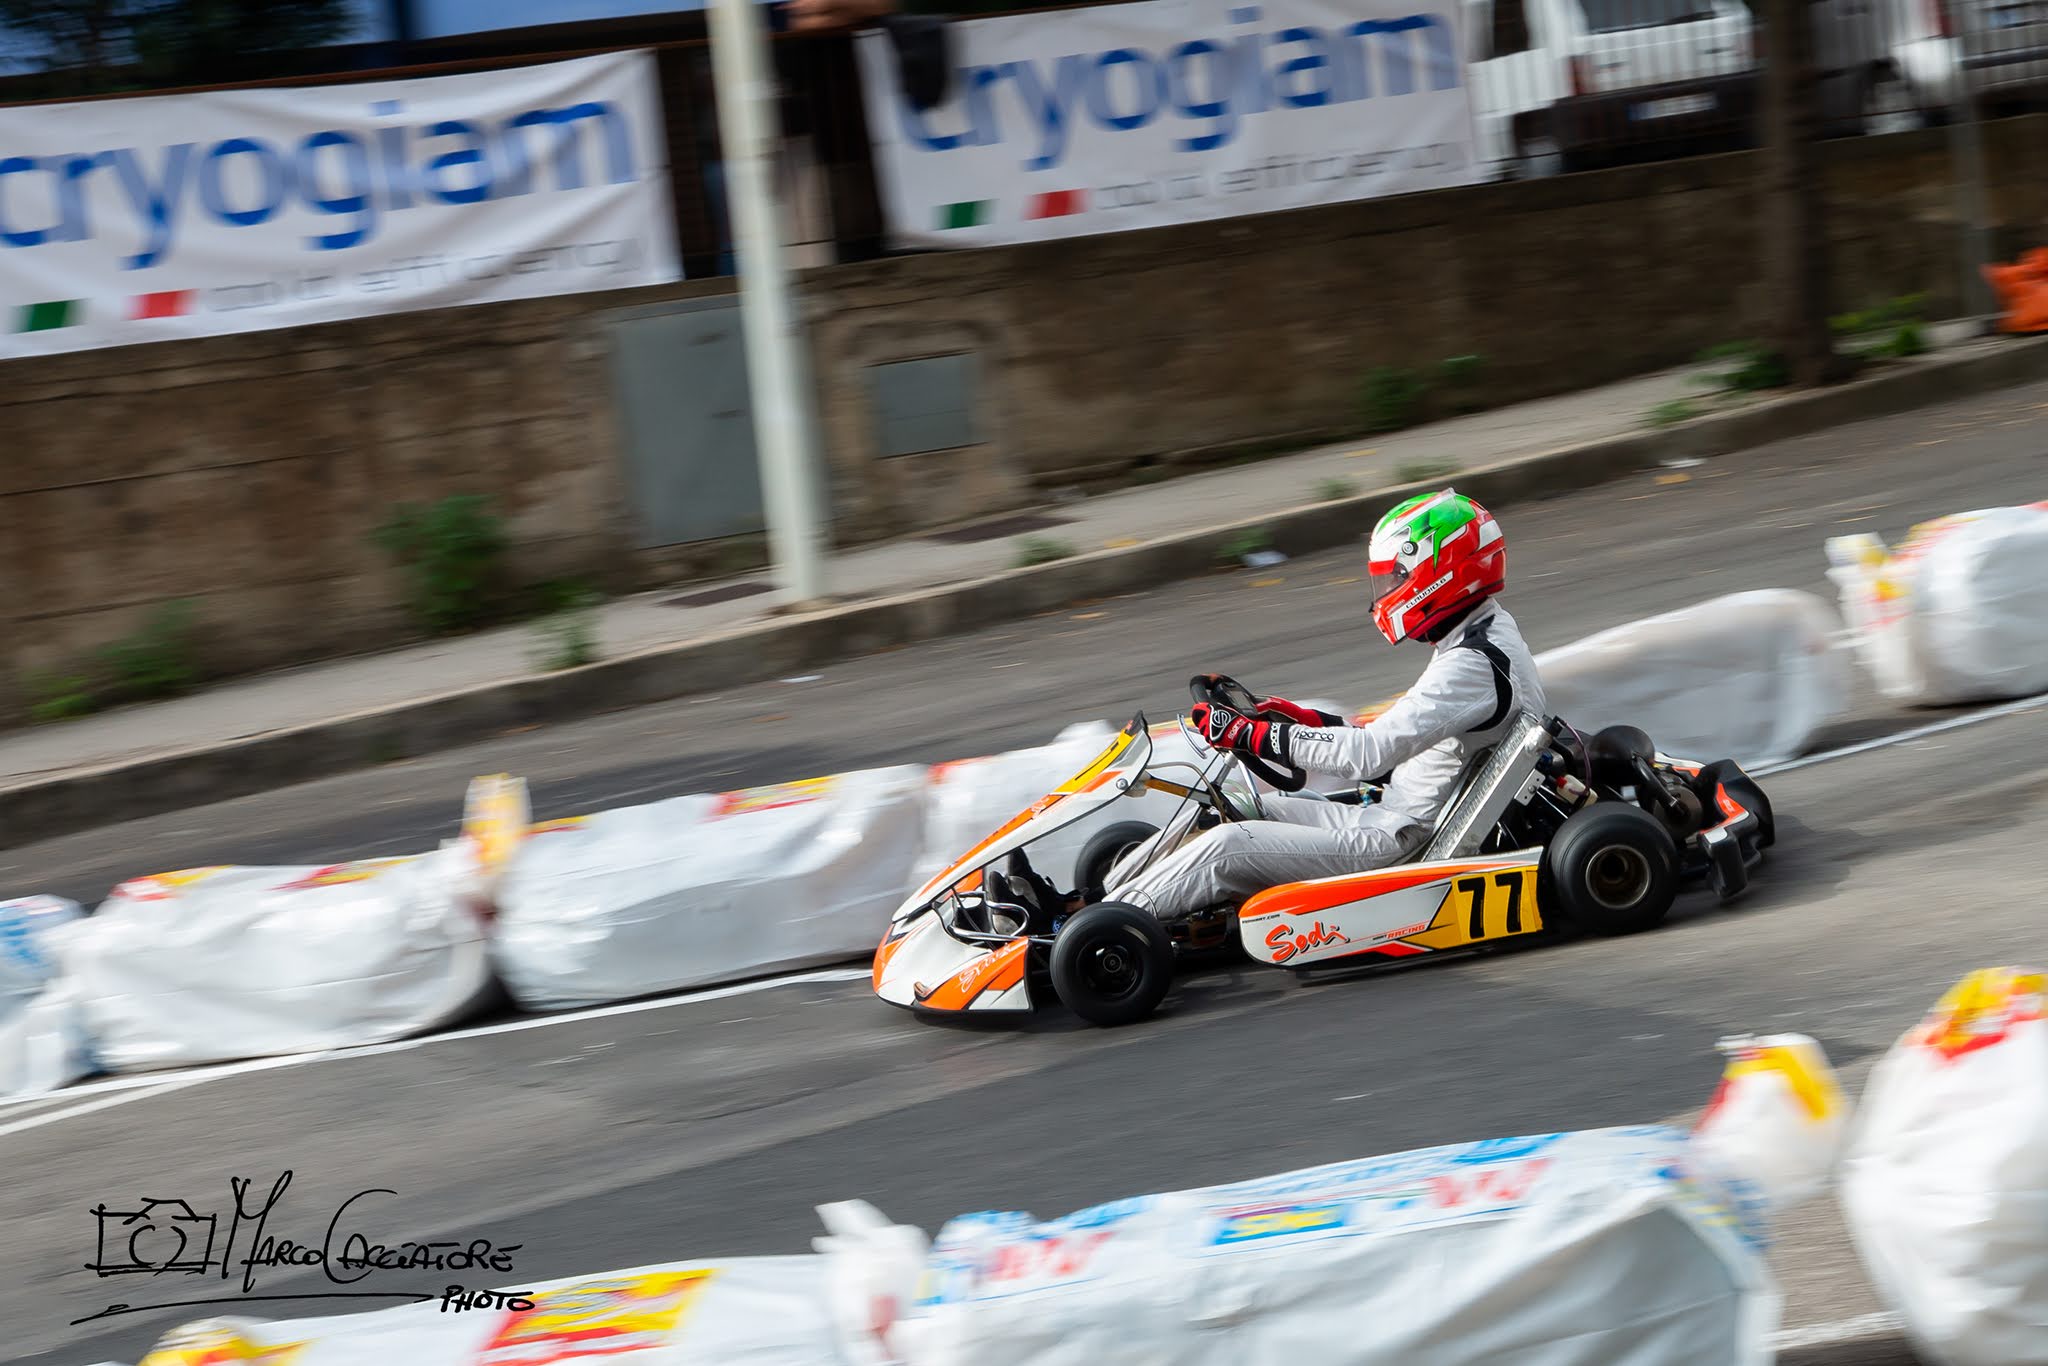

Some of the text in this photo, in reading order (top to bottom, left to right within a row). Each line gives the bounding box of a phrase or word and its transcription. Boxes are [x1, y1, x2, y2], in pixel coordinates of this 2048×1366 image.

[0, 100, 640, 271] cryogiam
[1387, 924, 1426, 939] RACING
[1458, 872, 1523, 940] 77
[1265, 921, 1351, 963] Sodi
